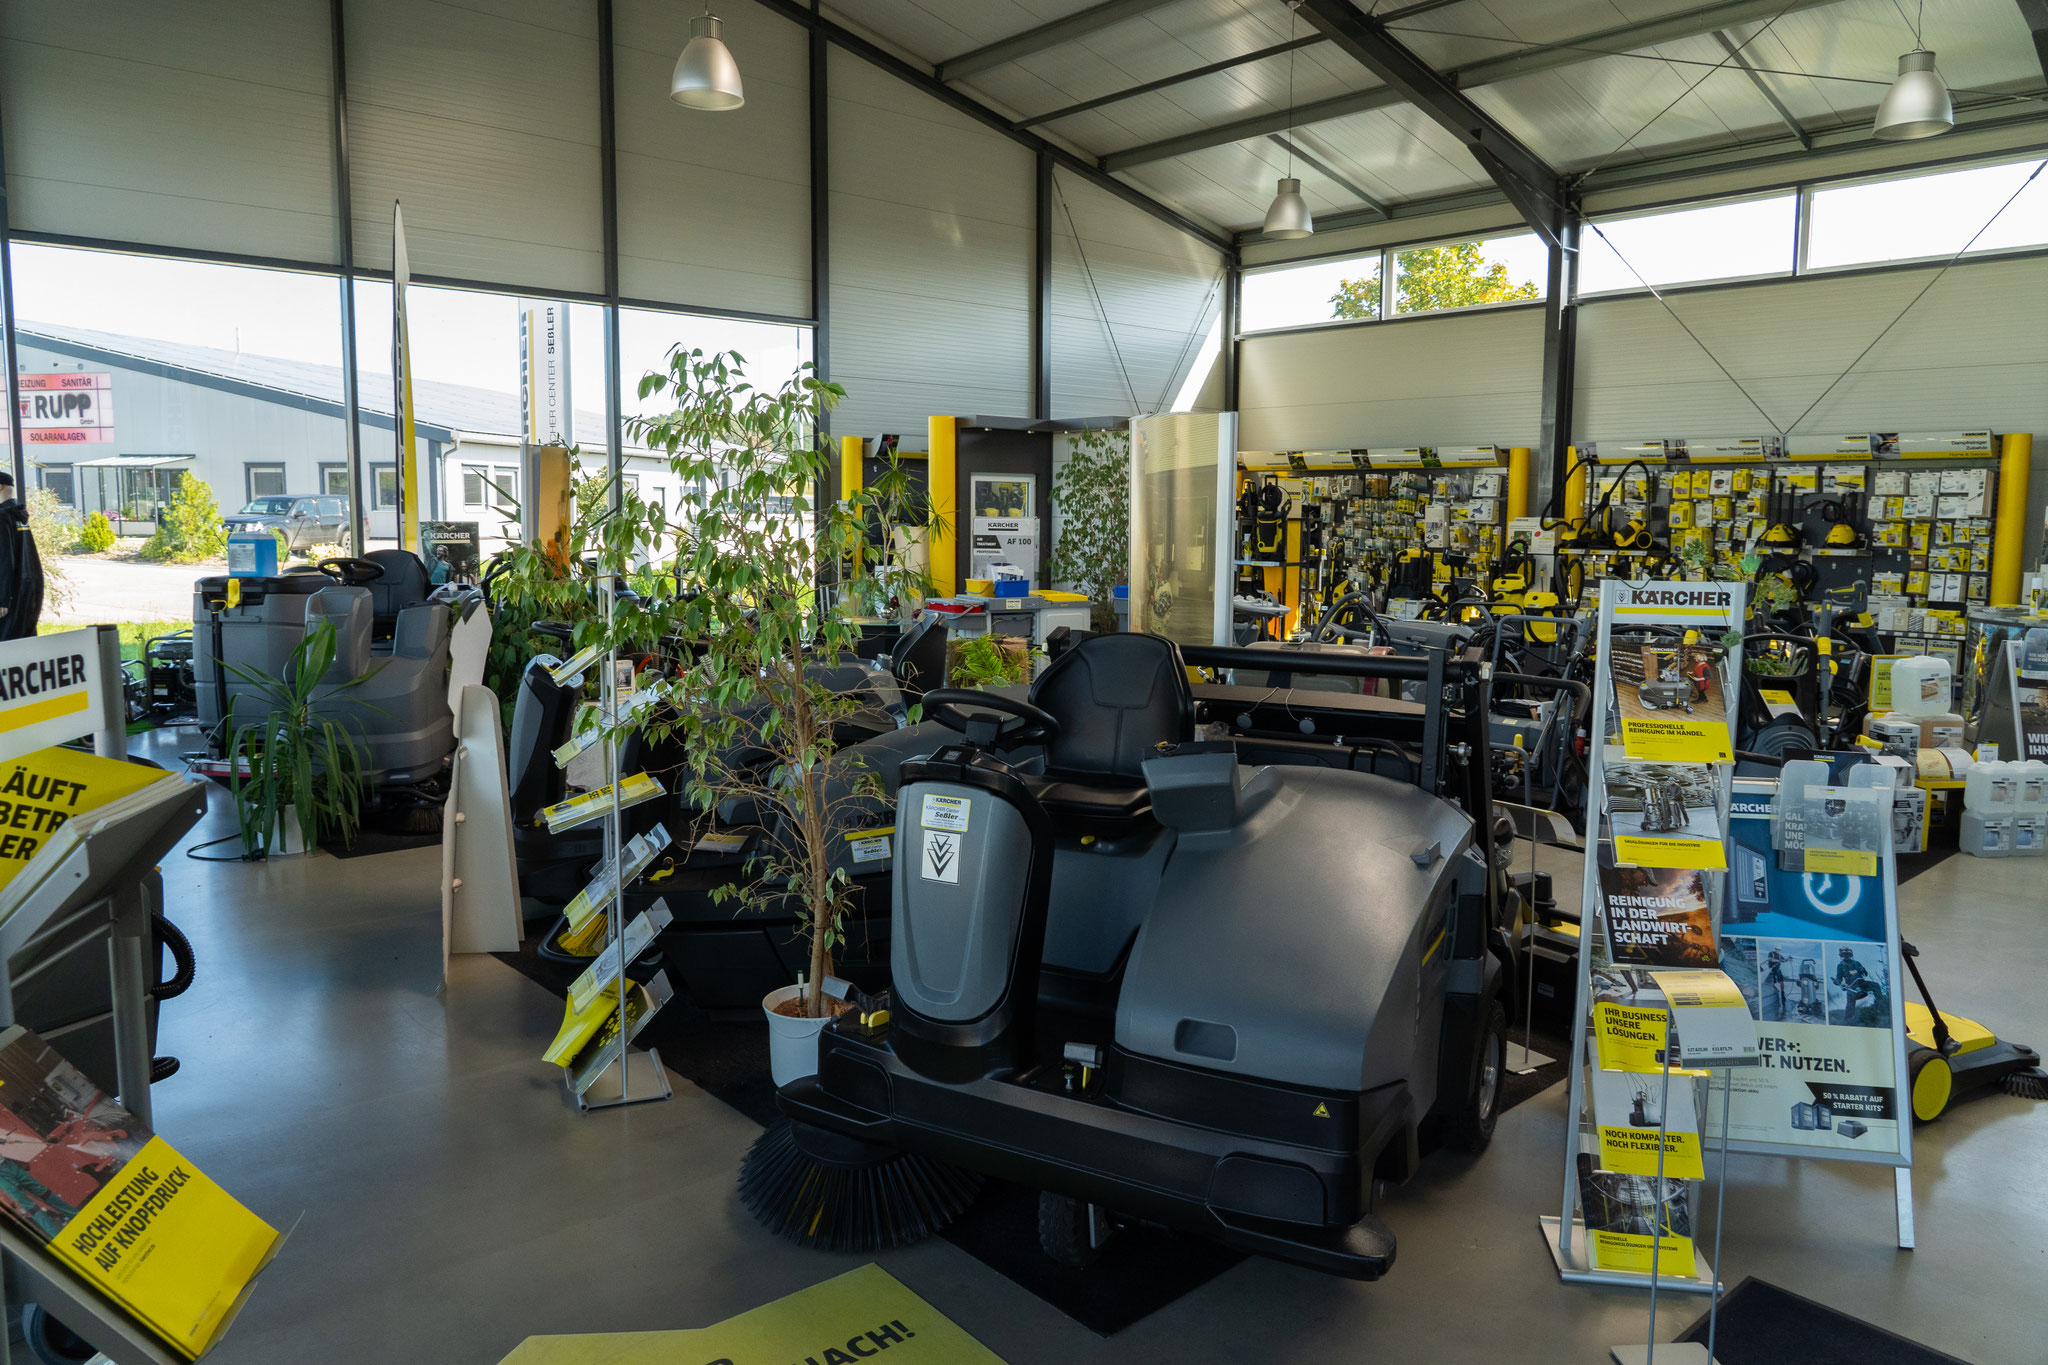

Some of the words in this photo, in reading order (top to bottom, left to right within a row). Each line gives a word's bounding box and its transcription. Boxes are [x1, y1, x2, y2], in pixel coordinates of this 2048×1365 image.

[20, 379, 47, 388] EIZUNG
[61, 378, 92, 387] SANITÄR
[548, 359, 556, 407] CENTER
[34, 393, 92, 419] RUPP
[30, 432, 87, 442] SOLARANLAGEN
[1631, 590, 1731, 606] KÄRCHER
[1628, 721, 1685, 730] PROFESSIONELLE
[1629, 727, 1665, 735] REINIGUNG
[0, 765, 88, 807] ÄUFT
[1608, 895, 1686, 909] REINIGUNG
[1611, 907, 1627, 918] IN
[1629, 908, 1658, 920] DER
[1612, 919, 1692, 934] LANDWIRT-
[1614, 932, 1669, 945] SCHAFT
[1604, 1007, 1620, 1017] IHR
[1605, 1016, 1641, 1030] UNSERE
[1606, 1026, 1659, 1042] LÖSUNGEN.
[1780, 1055, 1851, 1074] NUTZEN.
[1840, 1094, 1868, 1102] RABATT
[1869, 1095, 1883, 1103] AUF
[1833, 1102, 1864, 1111] STARTER
[1605, 1129, 1628, 1140] NOCH
[1629, 1132, 1685, 1144] KOMPATER.
[1606, 1139, 1629, 1149] NOCH
[1630, 1141, 1678, 1153] FLEXIBER.
[71, 1166, 160, 1257] HOCHLEISTUNG
[94, 1241, 122, 1274] AUF
[113, 1165, 192, 1251] KNOPFDRUCK
